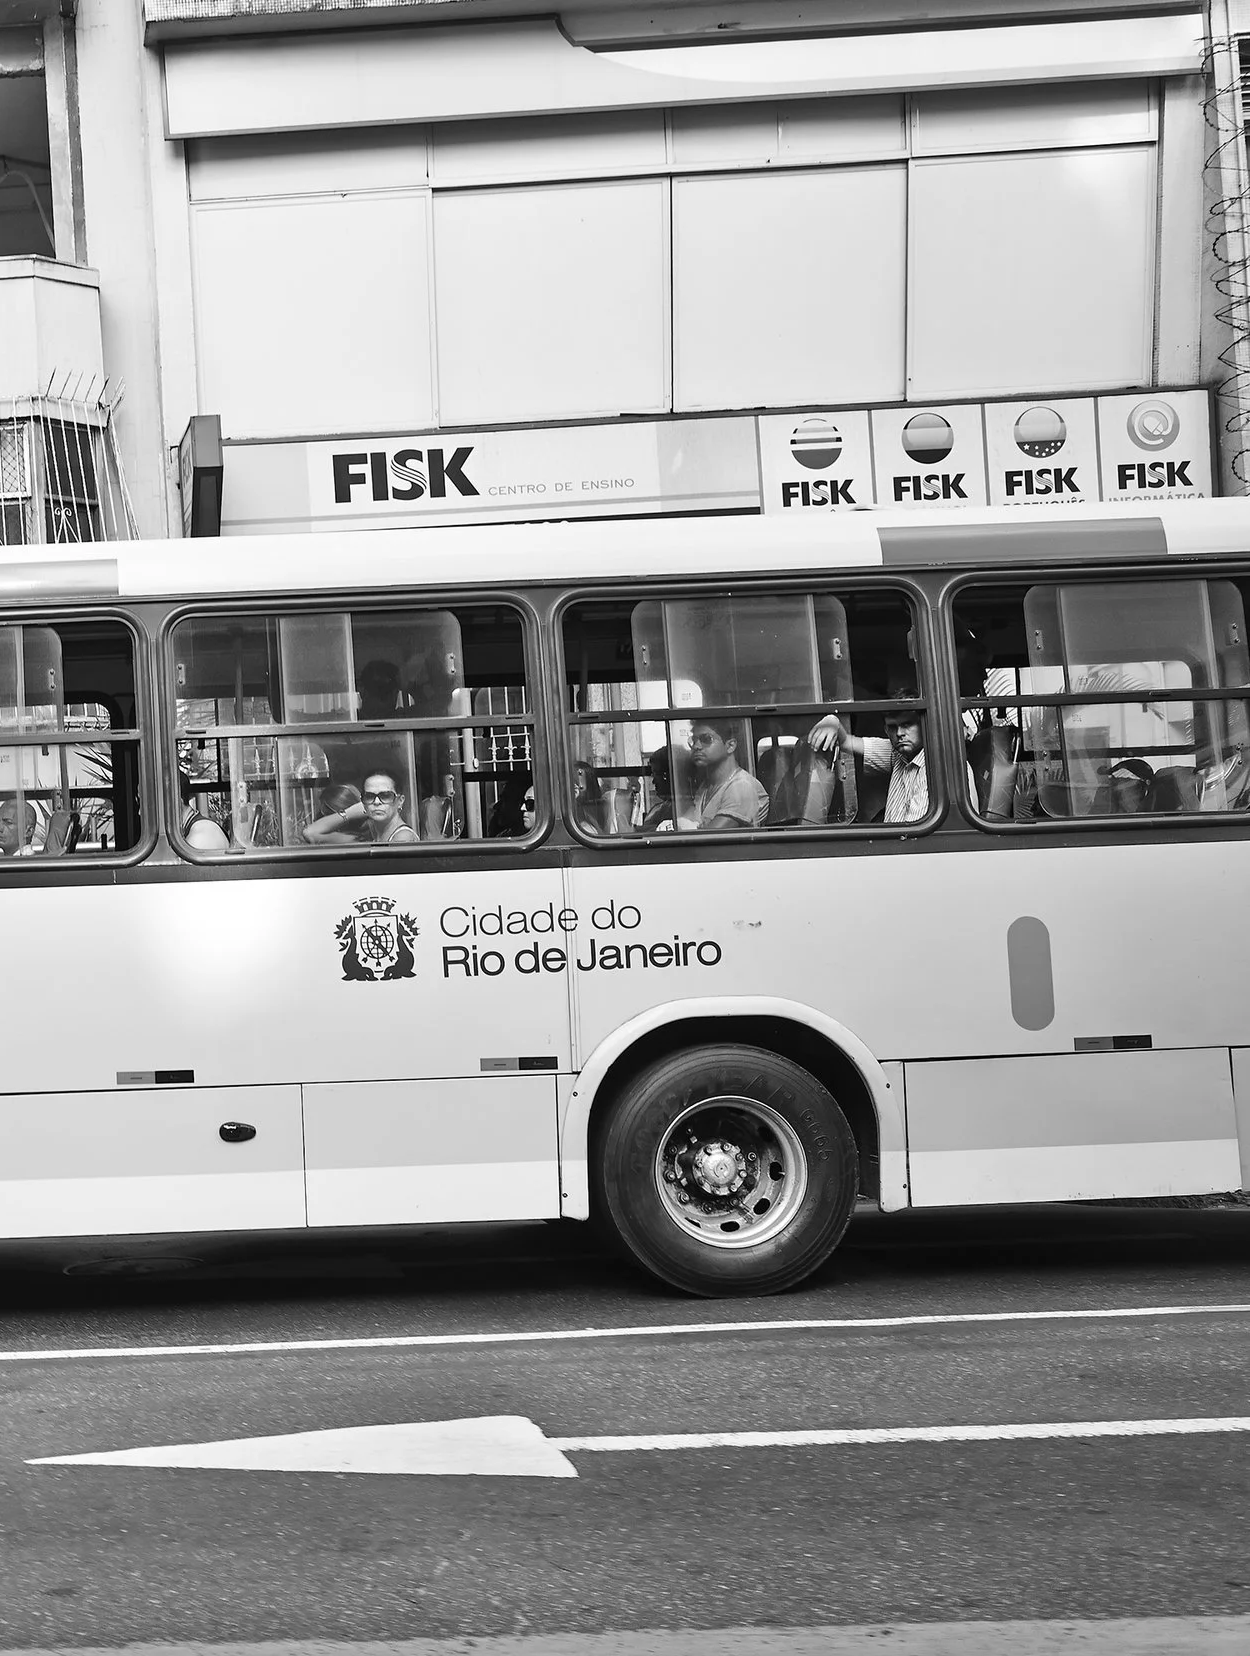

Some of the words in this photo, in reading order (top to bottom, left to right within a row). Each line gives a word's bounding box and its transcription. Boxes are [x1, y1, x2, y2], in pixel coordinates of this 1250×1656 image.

[332, 446, 480, 503] FISK
[488, 483, 547, 496] CENTRO
[554, 481, 573, 492] DE
[581, 478, 635, 490] ENSINO
[893, 473, 968, 501] FISK
[1005, 467, 1081, 496] FISK
[1117, 461, 1193, 490] FISK
[782, 479, 857, 507] FISK
[440, 902, 579, 938] Cidade
[591, 900, 642, 930] do
[442, 944, 506, 978] Rio
[514, 941, 567, 974] de
[576, 934, 722, 972] Janeiro
